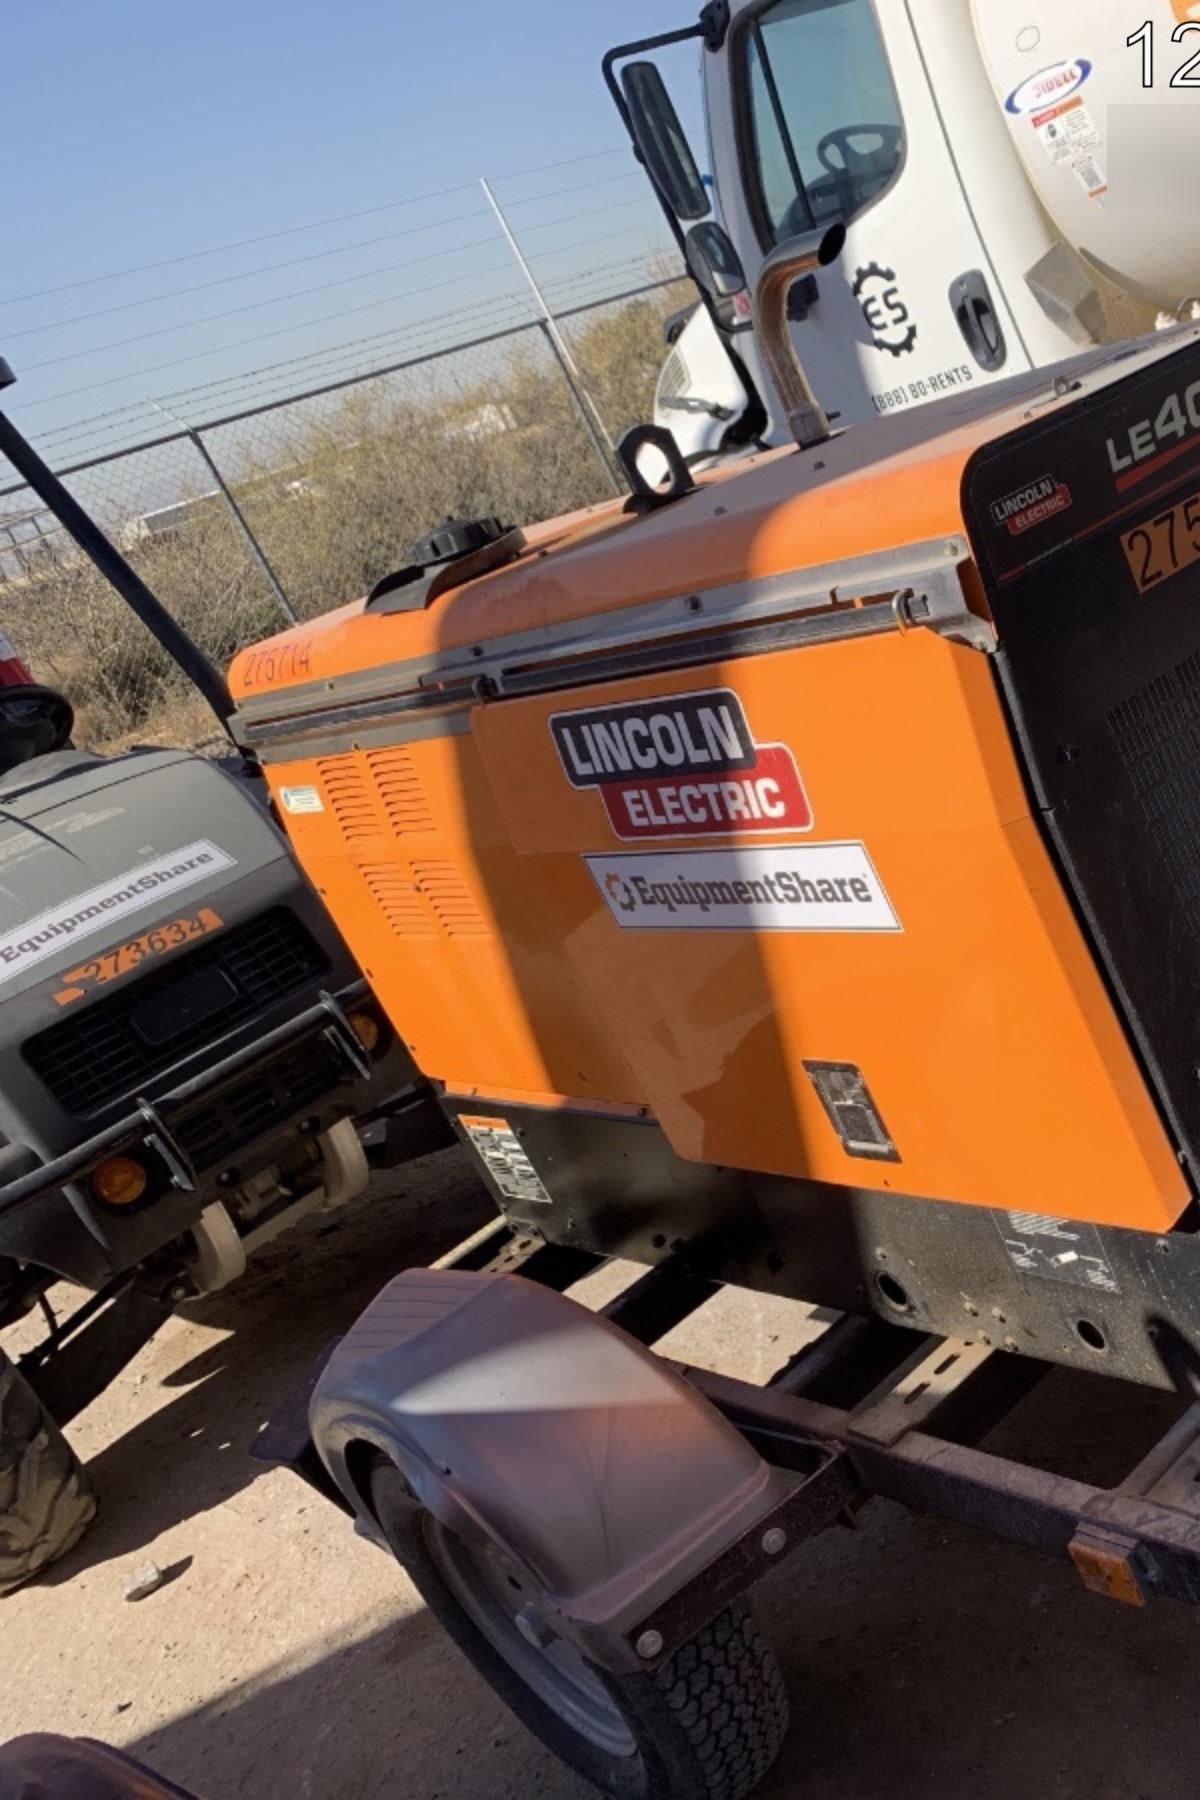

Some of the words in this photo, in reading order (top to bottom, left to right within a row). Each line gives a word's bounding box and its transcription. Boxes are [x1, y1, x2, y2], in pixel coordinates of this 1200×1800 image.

[909, 365, 973, 399] 80-RENTS
[996, 477, 1054, 521] LINCOLN
[1014, 493, 1066, 529] ELECTRIC
[243, 640, 313, 687] 275714
[561, 705, 744, 776] LINCOLN
[621, 777, 786, 828] ELECTRIC
[0, 852, 214, 963] EquipmentShare
[635, 871, 873, 912] EquipmentShare
[84, 917, 208, 983] 273634
